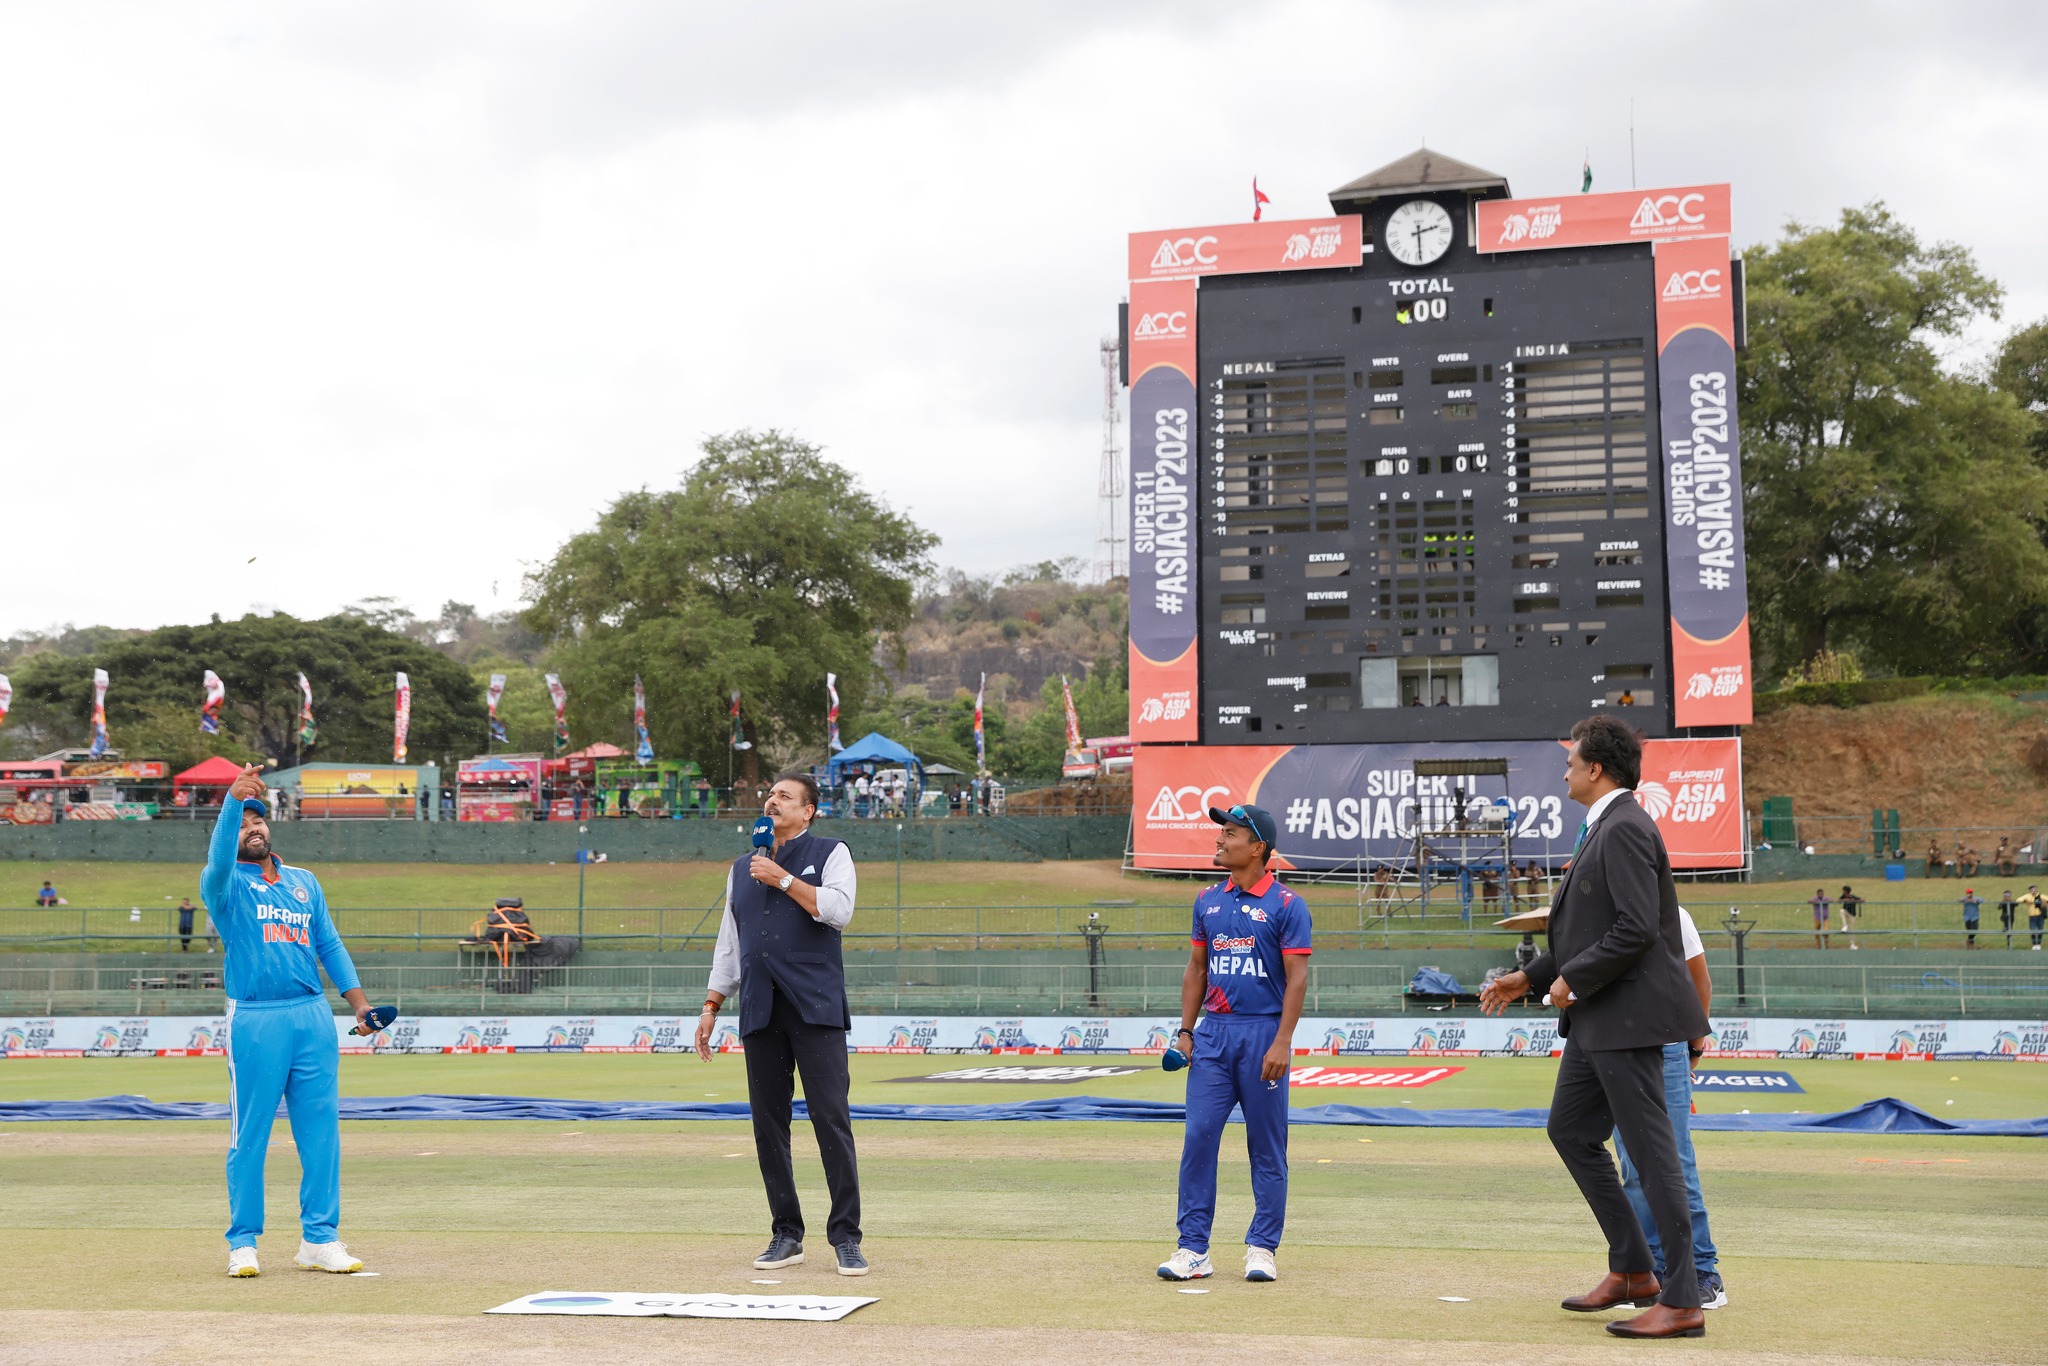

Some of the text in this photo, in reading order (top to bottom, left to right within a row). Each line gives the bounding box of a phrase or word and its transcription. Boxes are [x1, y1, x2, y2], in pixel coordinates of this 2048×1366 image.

[1630, 193, 1705, 228] ACC
[1531, 212, 1562, 227] ASIA
[1529, 224, 1556, 239] CUP
[1312, 233, 1342, 247] ASIA
[1150, 235, 1218, 269] ACC
[1311, 245, 1337, 258] CUP
[1388, 277, 1454, 296] TOTAL
[1662, 268, 1721, 297] ACC
[1134, 311, 1187, 336] ACC
[1516, 343, 1569, 357] INDIA
[1372, 357, 1400, 367] WKTS
[1437, 352, 1469, 363] OVERS
[1223, 361, 1275, 375] NEPAL
[1505, 362, 1513, 372] 1
[1216, 379, 1223, 389] 1
[1505, 378, 1515, 388] 2
[1215, 394, 1224, 405] 2
[1374, 392, 1398, 403] BATS
[1448, 389, 1472, 399] BATS
[1505, 392, 1515, 403] 3
[1215, 408, 1224, 419] 3
[1505, 407, 1516, 418] 4
[1215, 422, 1224, 434] 4
[1506, 424, 1516, 435] 5
[1215, 438, 1224, 450] 5
[1459, 442, 1485, 453] RUNS
[1506, 438, 1516, 448] 6
[1381, 446, 1408, 456] RUNS
[1507, 451, 1516, 462] 7
[1216, 452, 1224, 463] 6
[1216, 466, 1225, 478] 7
[1507, 466, 1517, 476] 8
[1216, 480, 1225, 491] 8
[1508, 481, 1517, 492] 9
[1669, 439, 1696, 527] SUPER 11
[1689, 371, 1735, 591] #ASIACUP2023
[1462, 489, 1473, 498] W
[1216, 496, 1226, 507] 9
[1507, 497, 1518, 508] 10
[1134, 471, 1156, 554] SUPER 11
[1155, 408, 1188, 615] #ASIACUP2023
[1216, 511, 1226, 523] 10
[1507, 513, 1517, 523] 11
[1216, 525, 1226, 536] 11
[1600, 540, 1639, 551] EXTRAS
[1308, 552, 1345, 563] EXTRAS
[1523, 582, 1548, 594] DLS
[1597, 579, 1641, 590] REVIEWS
[1306, 590, 1348, 601] REVIEWS
[1219, 629, 1256, 640] FALL OF
[1229, 636, 1256, 645] WKTS
[1267, 676, 1306, 686] INNINGS
[1714, 673, 1743, 686] ASIA
[1713, 684, 1738, 697] CUP
[1165, 698, 1191, 711] ASIA
[1218, 705, 1251, 715] POWER
[1163, 708, 1186, 720] CUP
[1219, 715, 1242, 725] PLAY
[1367, 769, 1449, 797] SUPER
[1674, 783, 1726, 803] ASIA
[1145, 785, 1231, 821] ACC
[1671, 802, 1717, 823] CUP
[1145, 822, 1224, 830] ASIAN CRICKET COUN
[1212, 936, 1255, 951] Second
[1209, 956, 1268, 978] NEPAL
[570, 1028, 594, 1037] ASIA
[656, 1028, 680, 1037] ASIA
[913, 1028, 937, 1038] ASIA
[998, 1028, 1023, 1038] ASIA
[1084, 1029, 1109, 1038] ASIA
[1349, 1030, 1374, 1039] ASIA
[1440, 1030, 1466, 1039] ASIA
[1532, 1030, 1558, 1039] ASIA
[1721, 1030, 1748, 1040] ASIA
[1819, 1031, 1847, 1041] ASIA
[1918, 1032, 1947, 1042] ASIA
[568, 1038, 589, 1047] CUP
[654, 1038, 675, 1047] CUP
[911, 1038, 932, 1048] CUP
[1082, 1038, 1103, 1048] CUP
[1347, 1040, 1369, 1050] CUP
[1438, 1040, 1460, 1050] CUP
[1530, 1040, 1553, 1051] CUP
[1719, 1041, 1743, 1051] CUP
[1817, 1042, 1841, 1052] CUP
[1917, 1043, 1941, 1054] CUP
[1289, 1066, 1448, 1086] Amul
[634, 1299, 845, 1311] Groww
